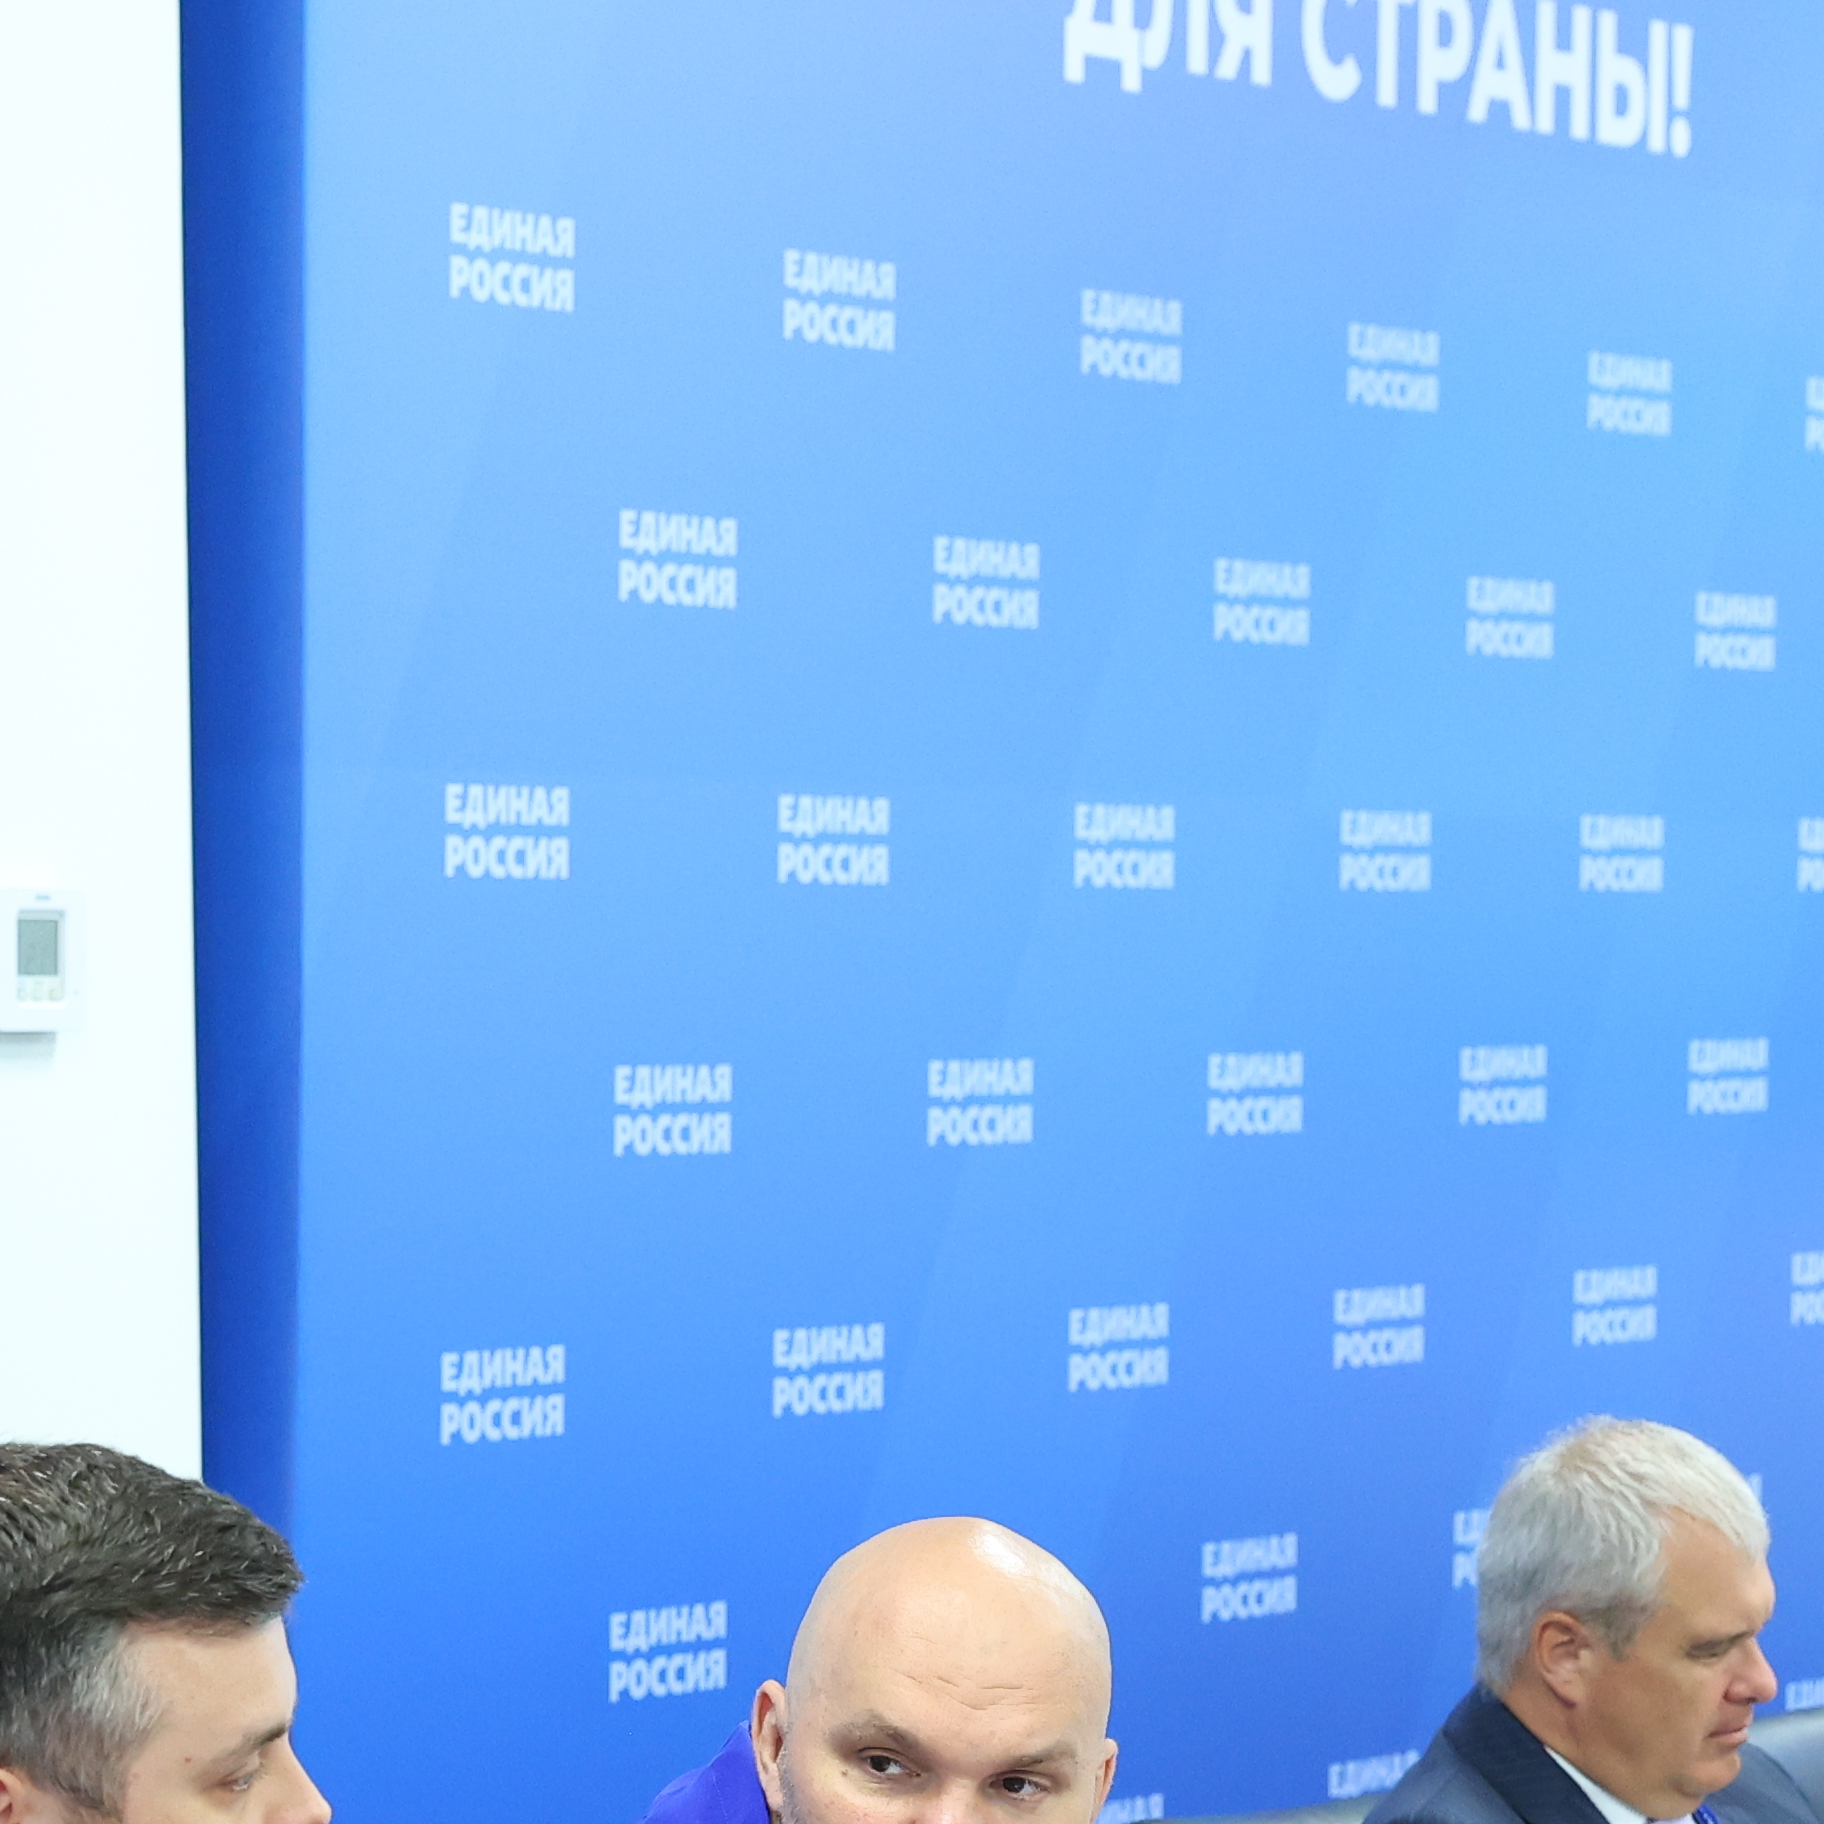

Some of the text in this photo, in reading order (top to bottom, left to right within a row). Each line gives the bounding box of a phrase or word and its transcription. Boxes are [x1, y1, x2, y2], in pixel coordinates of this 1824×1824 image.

[1064, 0, 1694, 158] ДЛЯ СТРАНЫ!
[450, 202, 575, 258] ЕДИНАЯ
[449, 255, 574, 312] РОССИЯ
[784, 249, 896, 300] ЕДИНАЯ
[783, 298, 895, 351] РОССИЯ
[1082, 290, 1181, 334] ЕДИНАЯ
[1081, 335, 1181, 383] РОССИЯ
[619, 509, 738, 556] ЕДИНАЯ
[934, 536, 1040, 580] ЕДИНАЯ
[1214, 558, 1310, 598] ЕДИНАЯ
[618, 559, 737, 609] РОССИЯ
[933, 583, 1039, 629] РОССИЯ
[1214, 603, 1310, 645] РОССИЯ
[445, 783, 570, 830] ЕДИНАЯ
[778, 793, 890, 838] ЕДИНАЯ
[1074, 802, 1175, 845] ЕДИНАЯ
[444, 834, 570, 880] РОССИЯ
[777, 842, 890, 885] РОССИЯ
[1074, 848, 1175, 889] РОССИЯ
[614, 1063, 732, 1110] ЕДИНАЯ
[928, 1058, 1034, 1101] ЕДИНАЯ
[1208, 1052, 1304, 1093] ЕДИНАЯ
[614, 1112, 732, 1156] РОССИЯ
[927, 1104, 1033, 1146] РОССИЯ
[1207, 1095, 1303, 1136] РОССИЯ
[773, 1323, 885, 1371] ЕДИНАЯ
[1068, 1303, 1169, 1348] ЕДИНАЯ
[441, 1344, 566, 1397] ЕДИНАЯ
[1068, 1346, 1169, 1392] РОССИЯ
[773, 1369, 884, 1418] РОССИЯ
[440, 1393, 565, 1446] РОССИЯ
[1202, 1532, 1298, 1579] ЕДИНАЯ
[609, 1601, 727, 1655] ЕДИНАЯ
[609, 1649, 727, 1703] РОССИЯ
